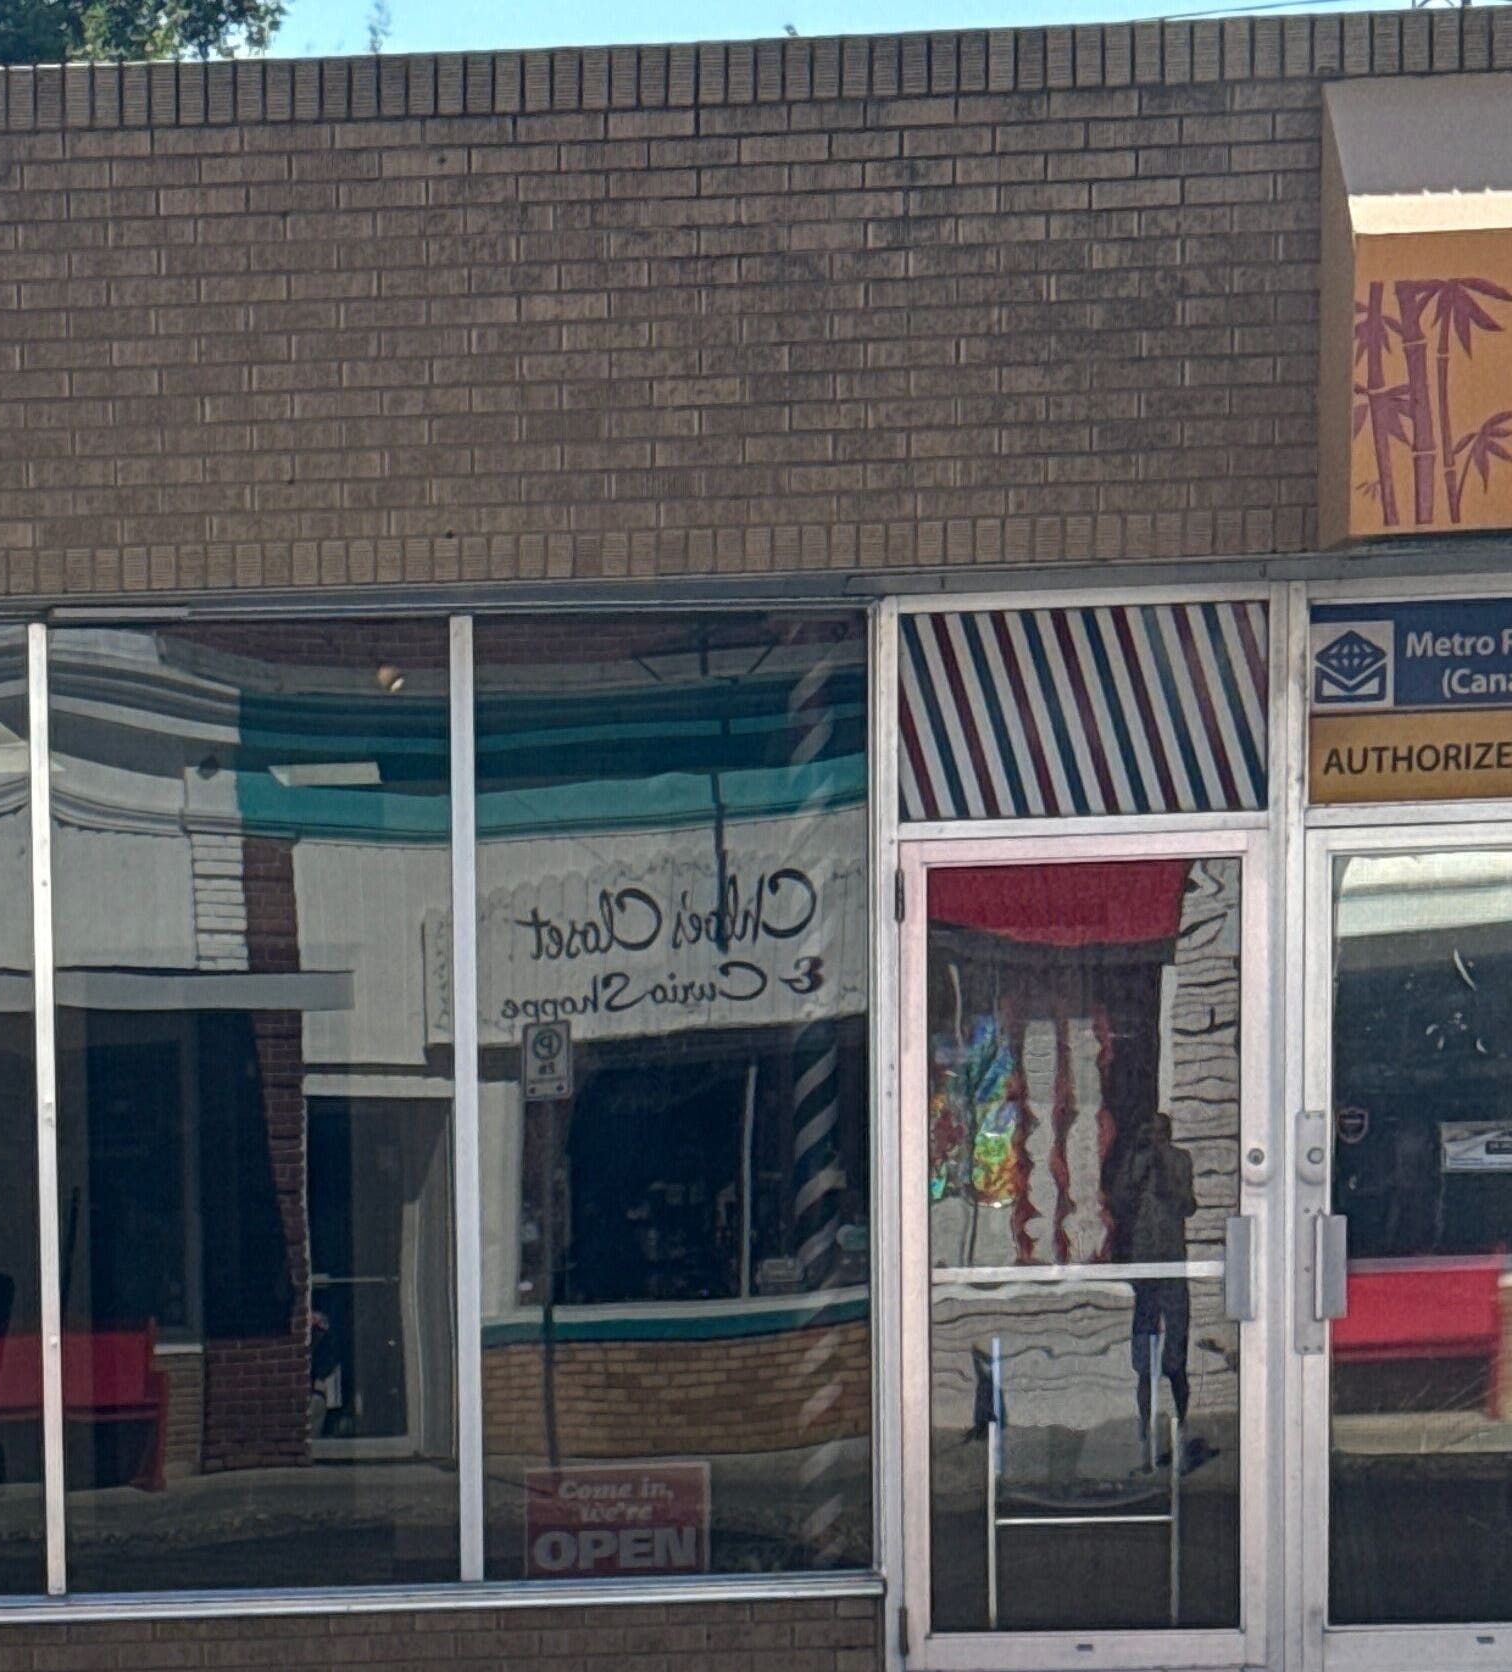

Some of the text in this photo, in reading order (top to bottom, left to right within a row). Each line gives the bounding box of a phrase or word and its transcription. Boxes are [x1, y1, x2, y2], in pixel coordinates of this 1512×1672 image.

[1405, 630, 1496, 658] Metro
[1442, 668, 1512, 698] (Can
[1323, 741, 1512, 776] AUTHORIZE
[558, 1476, 674, 1501] Come in,
[534, 1526, 697, 1571] OPEN
